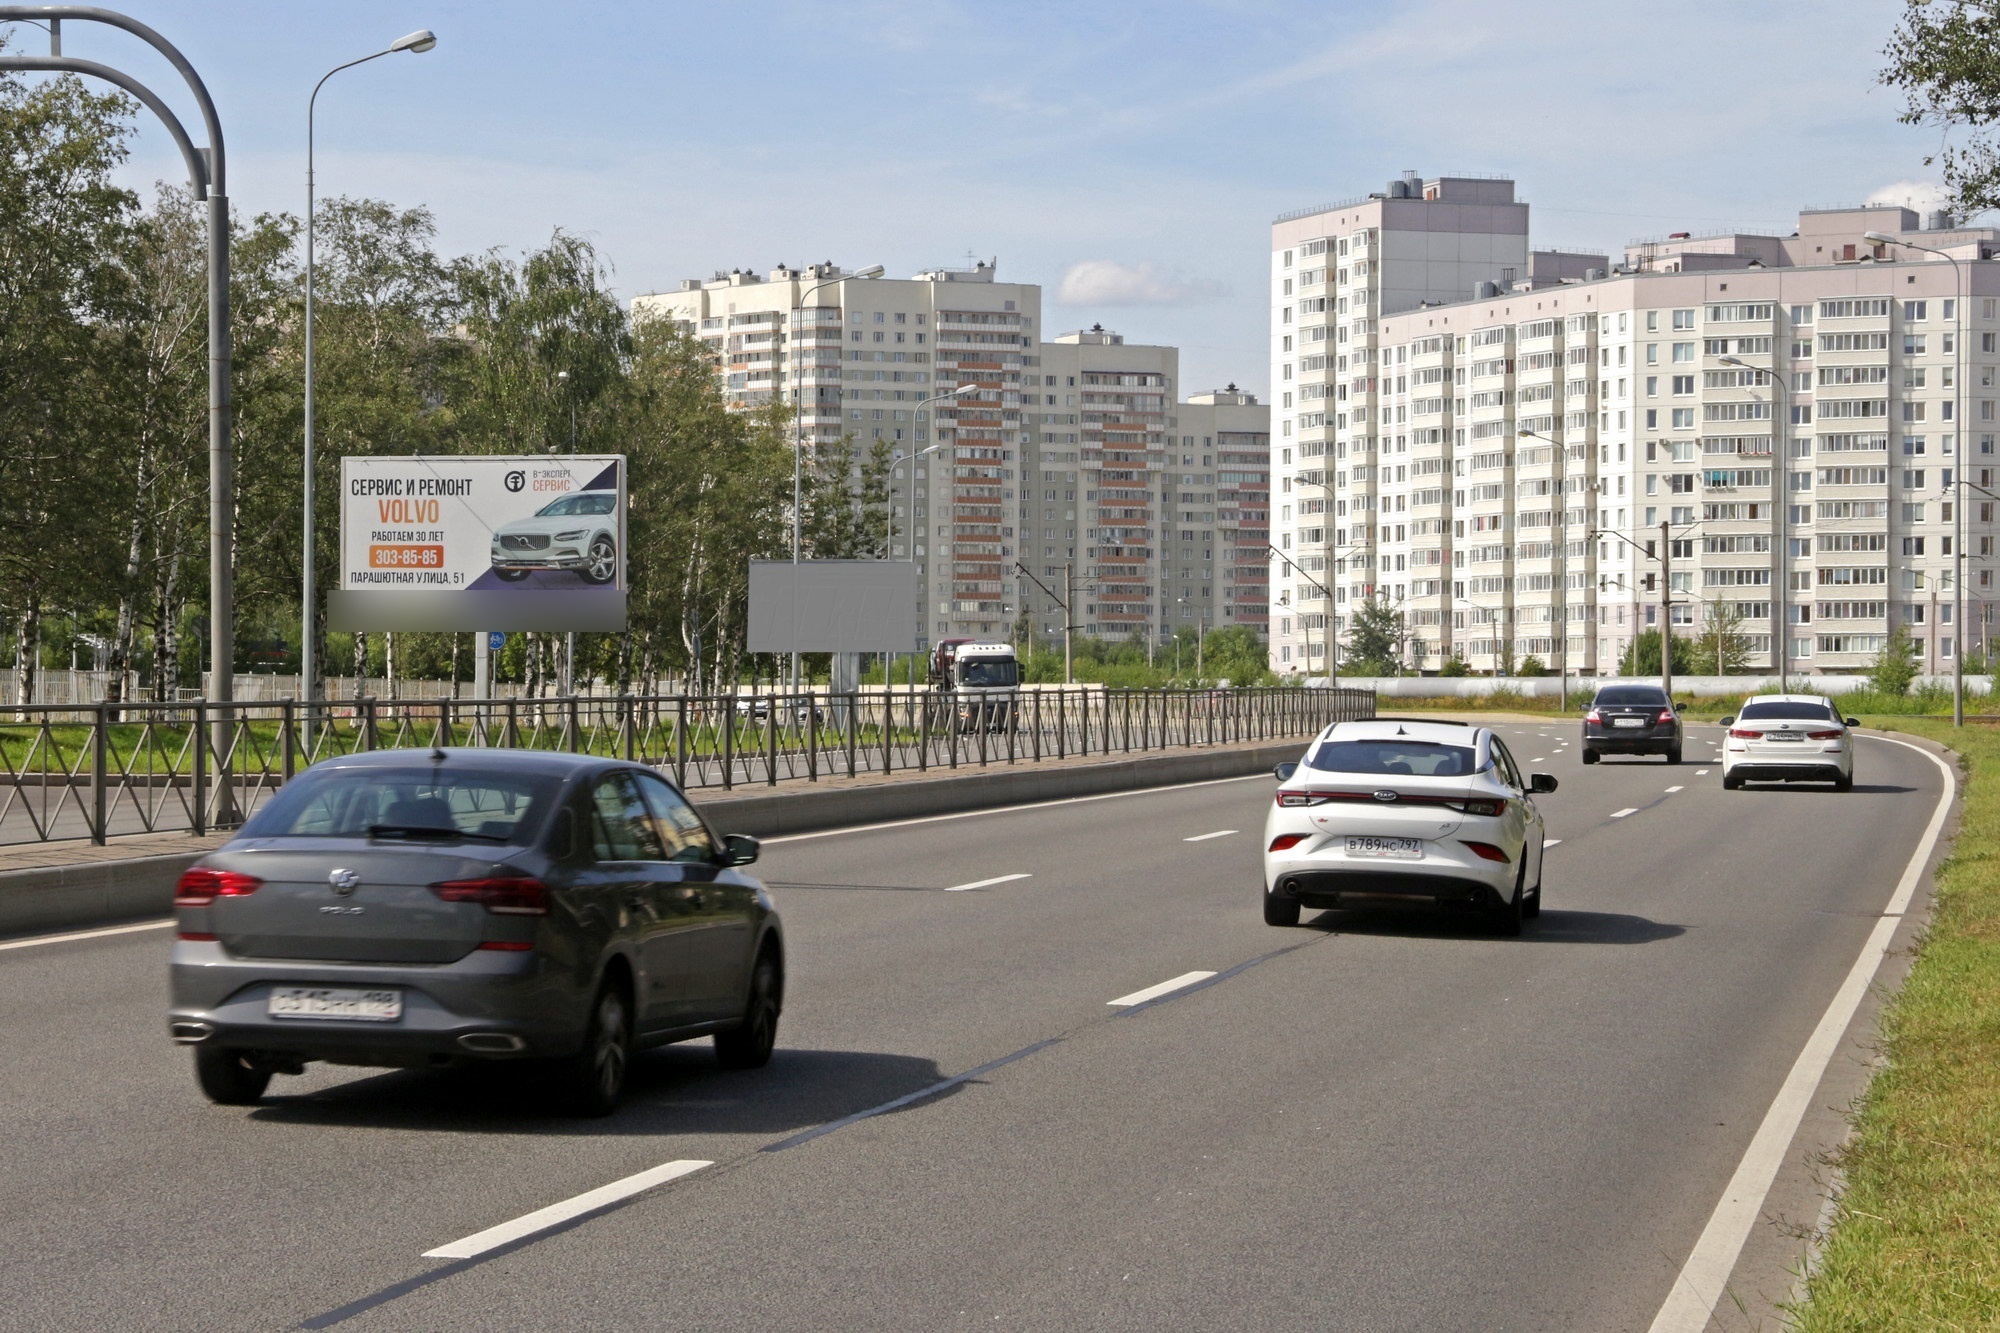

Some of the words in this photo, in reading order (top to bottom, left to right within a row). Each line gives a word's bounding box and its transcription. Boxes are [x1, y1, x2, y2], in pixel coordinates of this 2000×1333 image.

[351, 479, 403, 496] СЕРВИС
[406, 479, 415, 496] И
[419, 479, 472, 496] РЕМОНТ
[533, 480, 570, 491] СЕРВИС
[379, 499, 439, 523] VOLVO
[371, 531, 414, 542] РАБОТАЕМ
[416, 531, 426, 541] 30
[428, 531, 444, 541] ЛЕТ
[375, 549, 438, 565] 303-85-85
[350, 572, 414, 584] ПАРАШЮТНАЯ
[416, 572, 451, 585] УЛИЦА,
[453, 572, 465, 583] 51
[1399, 839, 1418, 850] 797
